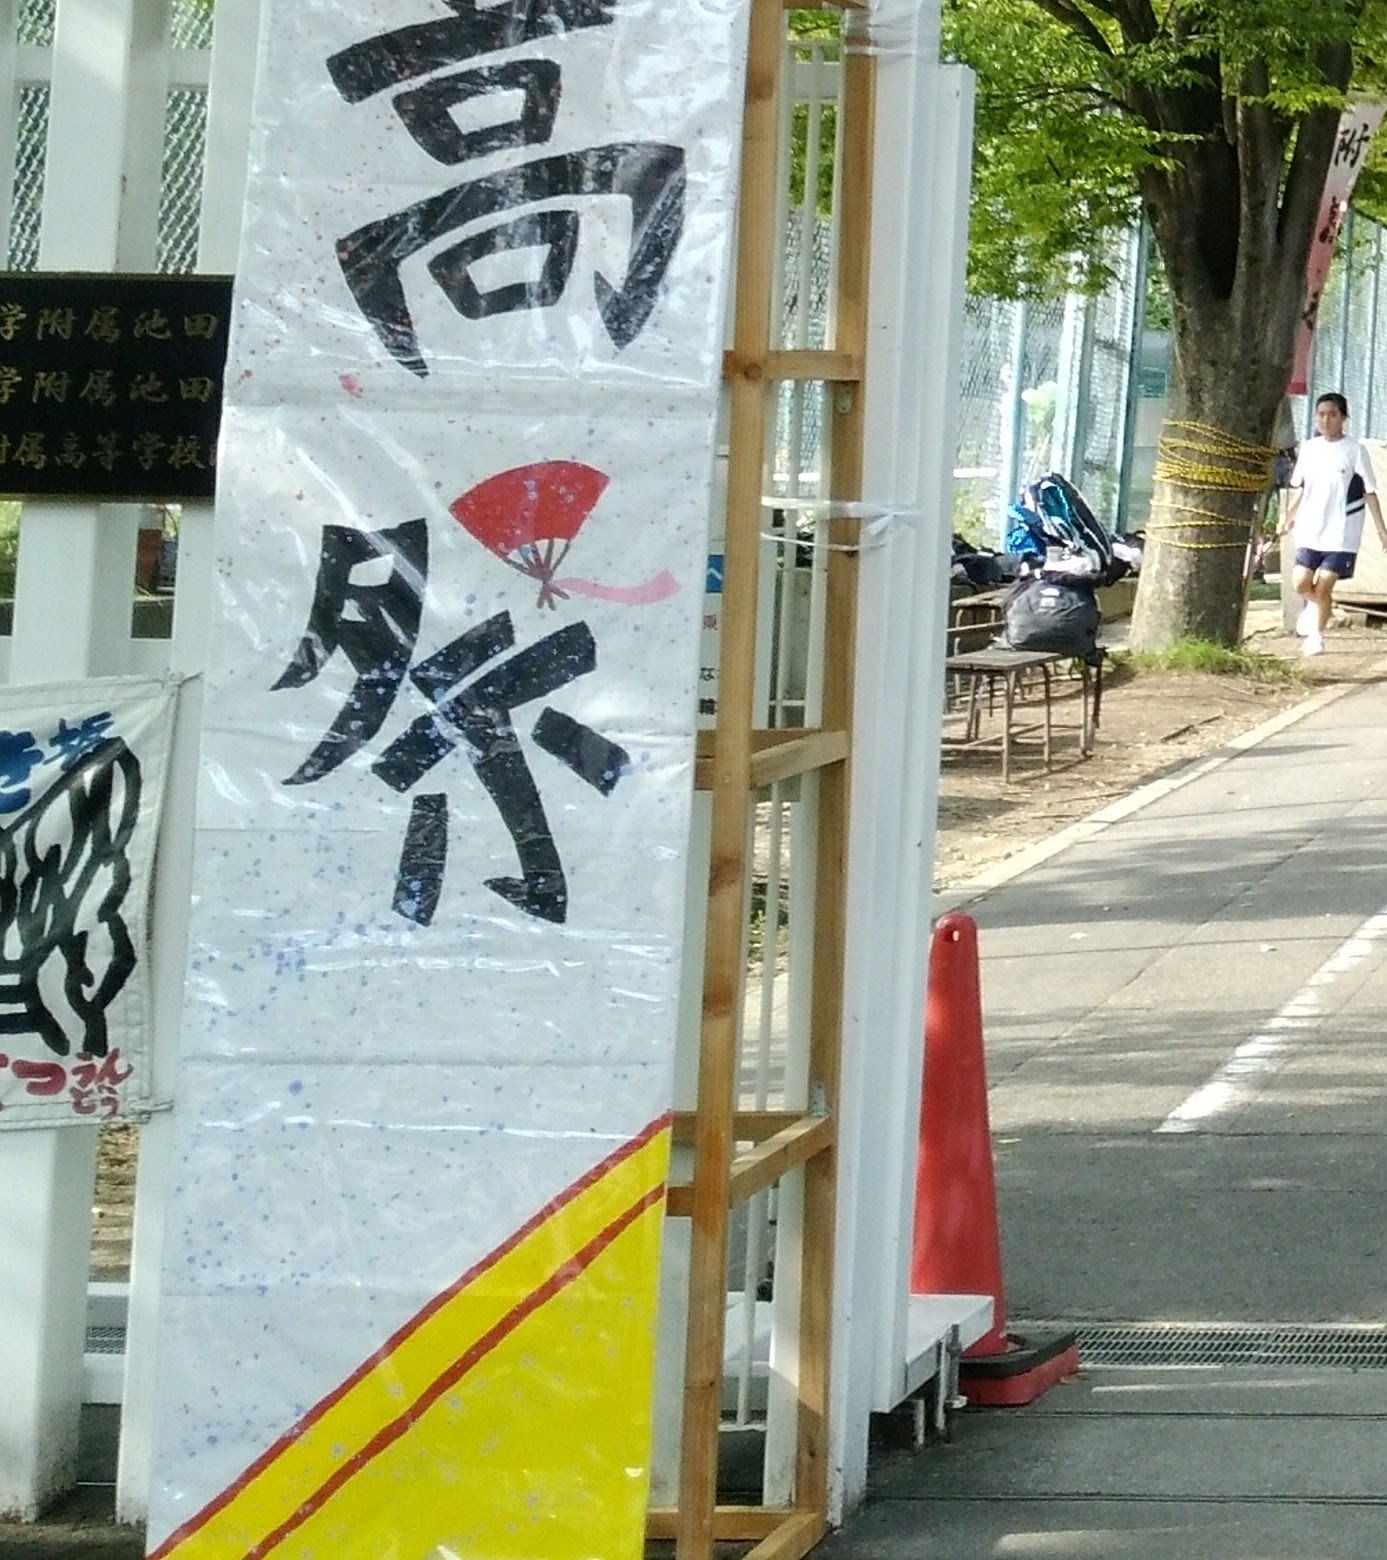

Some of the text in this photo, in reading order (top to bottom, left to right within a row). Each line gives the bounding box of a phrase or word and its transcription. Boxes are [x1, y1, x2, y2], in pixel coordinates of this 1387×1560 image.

[0, 432, 216, 471] 属高等学校
